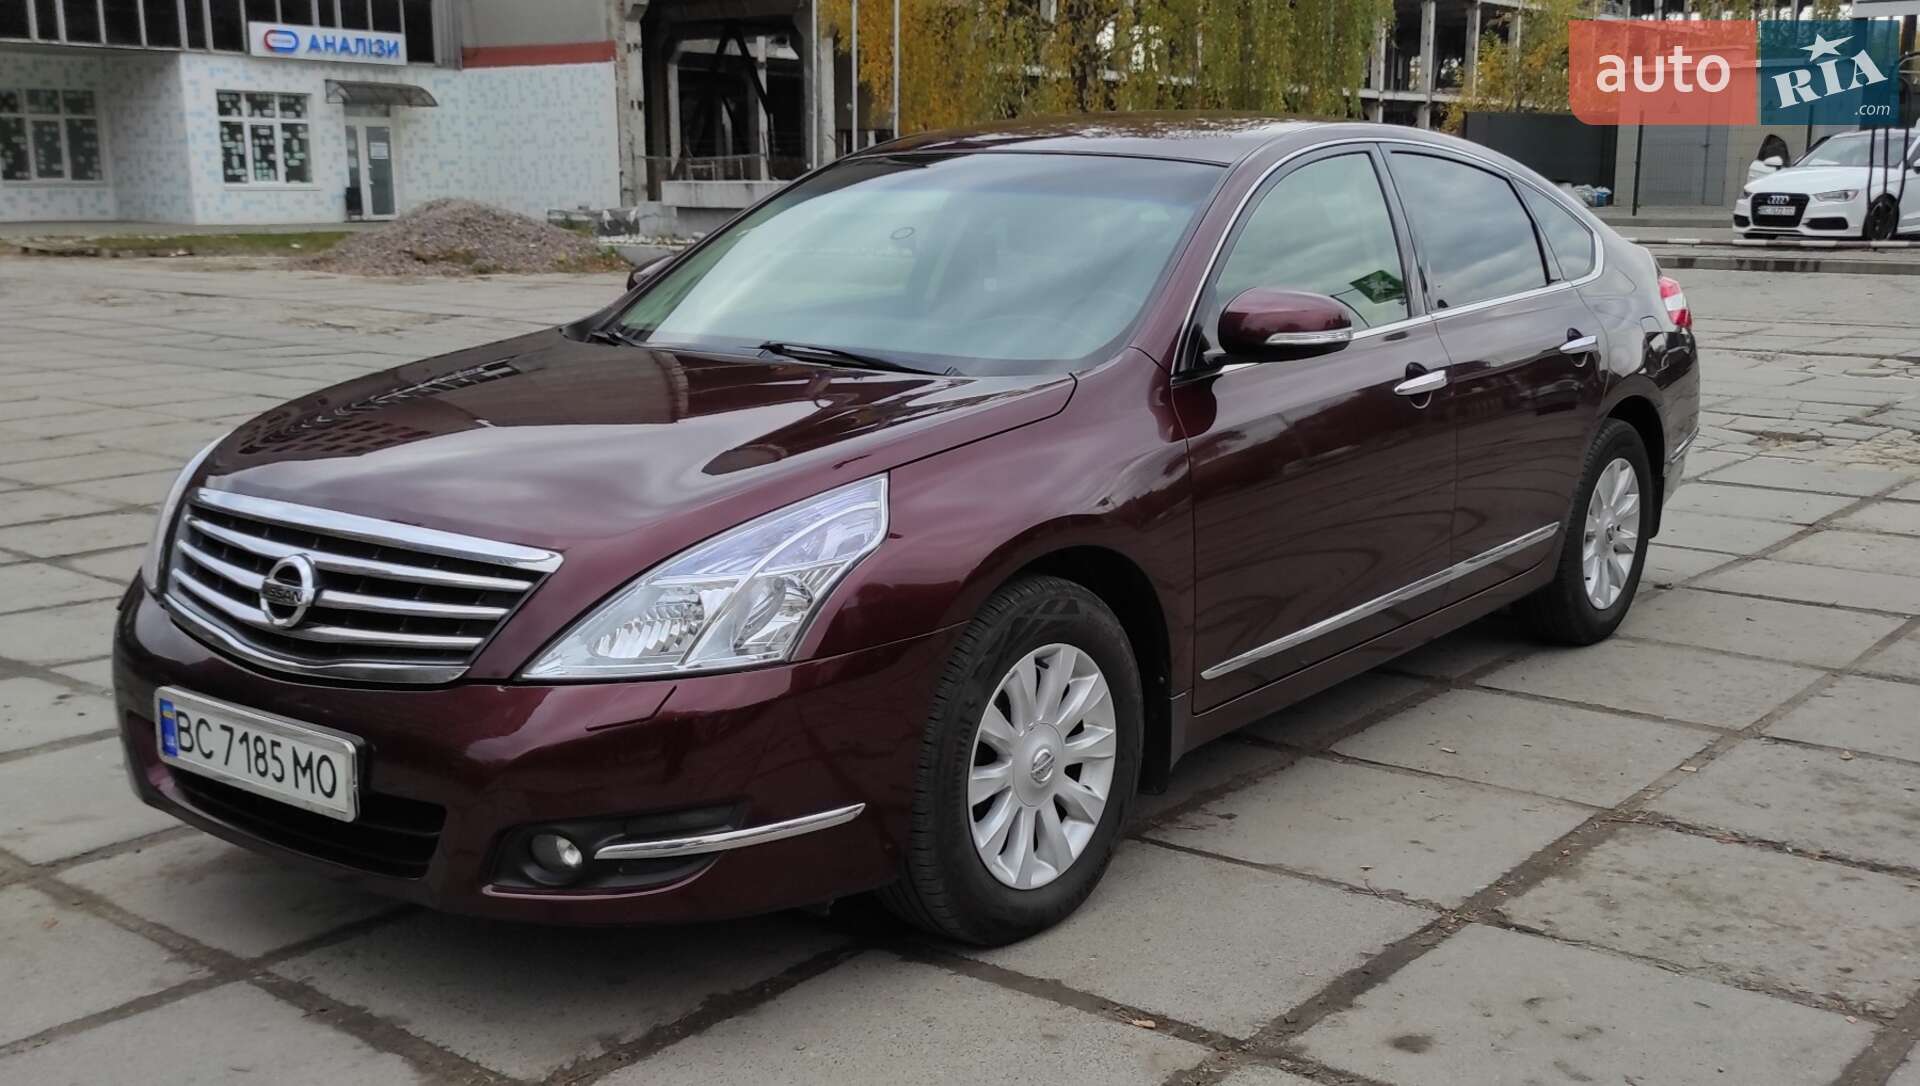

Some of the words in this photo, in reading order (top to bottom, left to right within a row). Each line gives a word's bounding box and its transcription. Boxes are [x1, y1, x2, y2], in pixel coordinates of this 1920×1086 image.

[307, 34, 399, 58] АНАЛІЗИ
[176, 711, 214, 760] BC
[220, 724, 285, 782] 7185
[292, 746, 336, 799] MO
